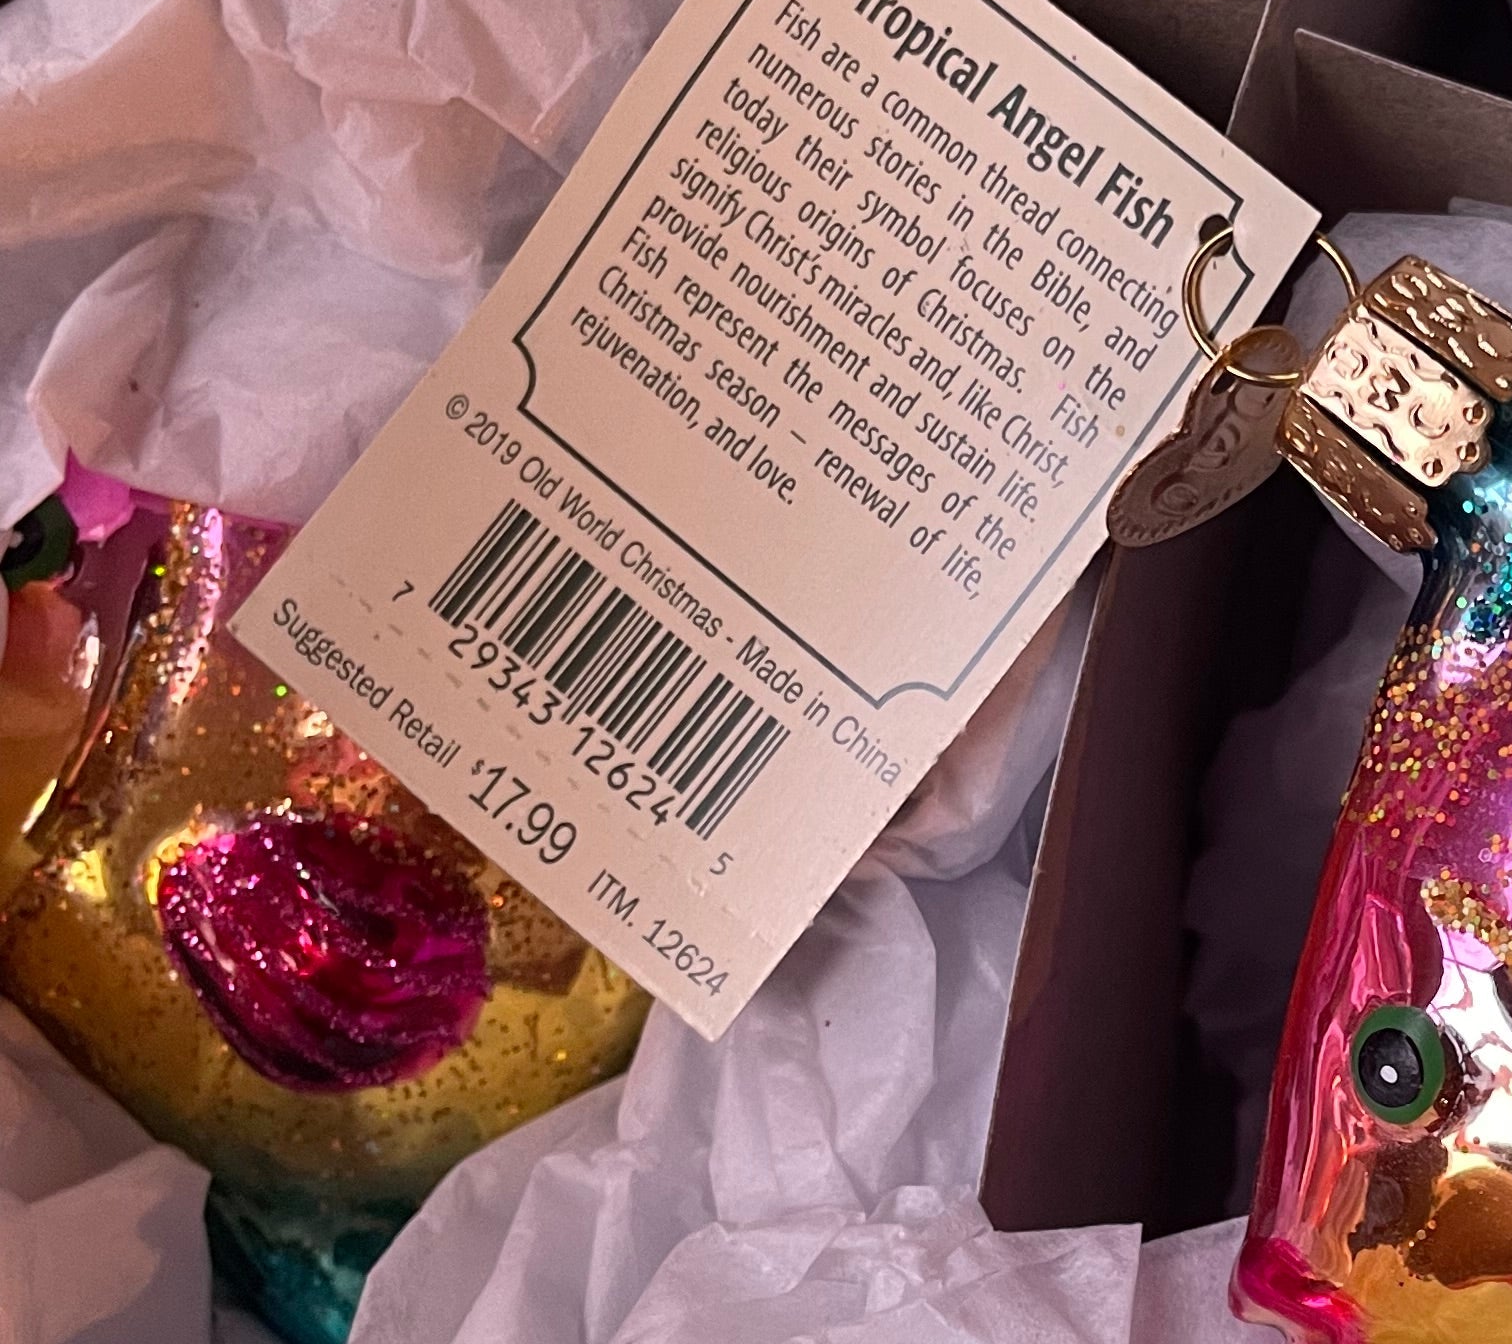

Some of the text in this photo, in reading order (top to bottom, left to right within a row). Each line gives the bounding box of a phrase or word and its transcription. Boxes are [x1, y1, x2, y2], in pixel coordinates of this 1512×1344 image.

[669, 157, 748, 229] signify
[818, 274, 913, 357] miracles
[908, 346, 962, 401] and,
[957, 377, 1002, 431] like
[1001, 414, 1069, 489] Christ,
[695, 118, 1099, 449] religious origins of Christmas. Fish
[722, 77, 1126, 411] today their symbol focuses on the
[747, 42, 1159, 373] numerous stories in the Bible, and
[820, 41, 861, 83] are
[860, 73, 880, 98] a
[881, 90, 978, 176] common
[979, 162, 1062, 236] thread
[1056, 228, 1180, 340] connecting
[986, 83, 1106, 189] Angel
[1094, 161, 1175, 250] Fish
[570, 305, 797, 506] rejuvenation, and love.
[598, 265, 703, 363] Christmas
[704, 359, 781, 429] season
[813, 447, 911, 529] renewal
[909, 526, 947, 555] of
[940, 543, 982, 601] life,
[620, 225, 1017, 560] Fish represent the messages of the
[641, 194, 1038, 523] provide nourishment and sustain life.
[391, 579, 734, 876] 7 29343 12624 5
[463, 411, 522, 466] 2019
[519, 455, 564, 501] Old
[558, 485, 626, 552] World
[620, 540, 724, 638] Christmas
[735, 634, 804, 705] Made
[802, 690, 831, 728] in
[832, 715, 902, 787] China
[273, 598, 729, 997] Suggested Retail $17.99 ITM. 12624
